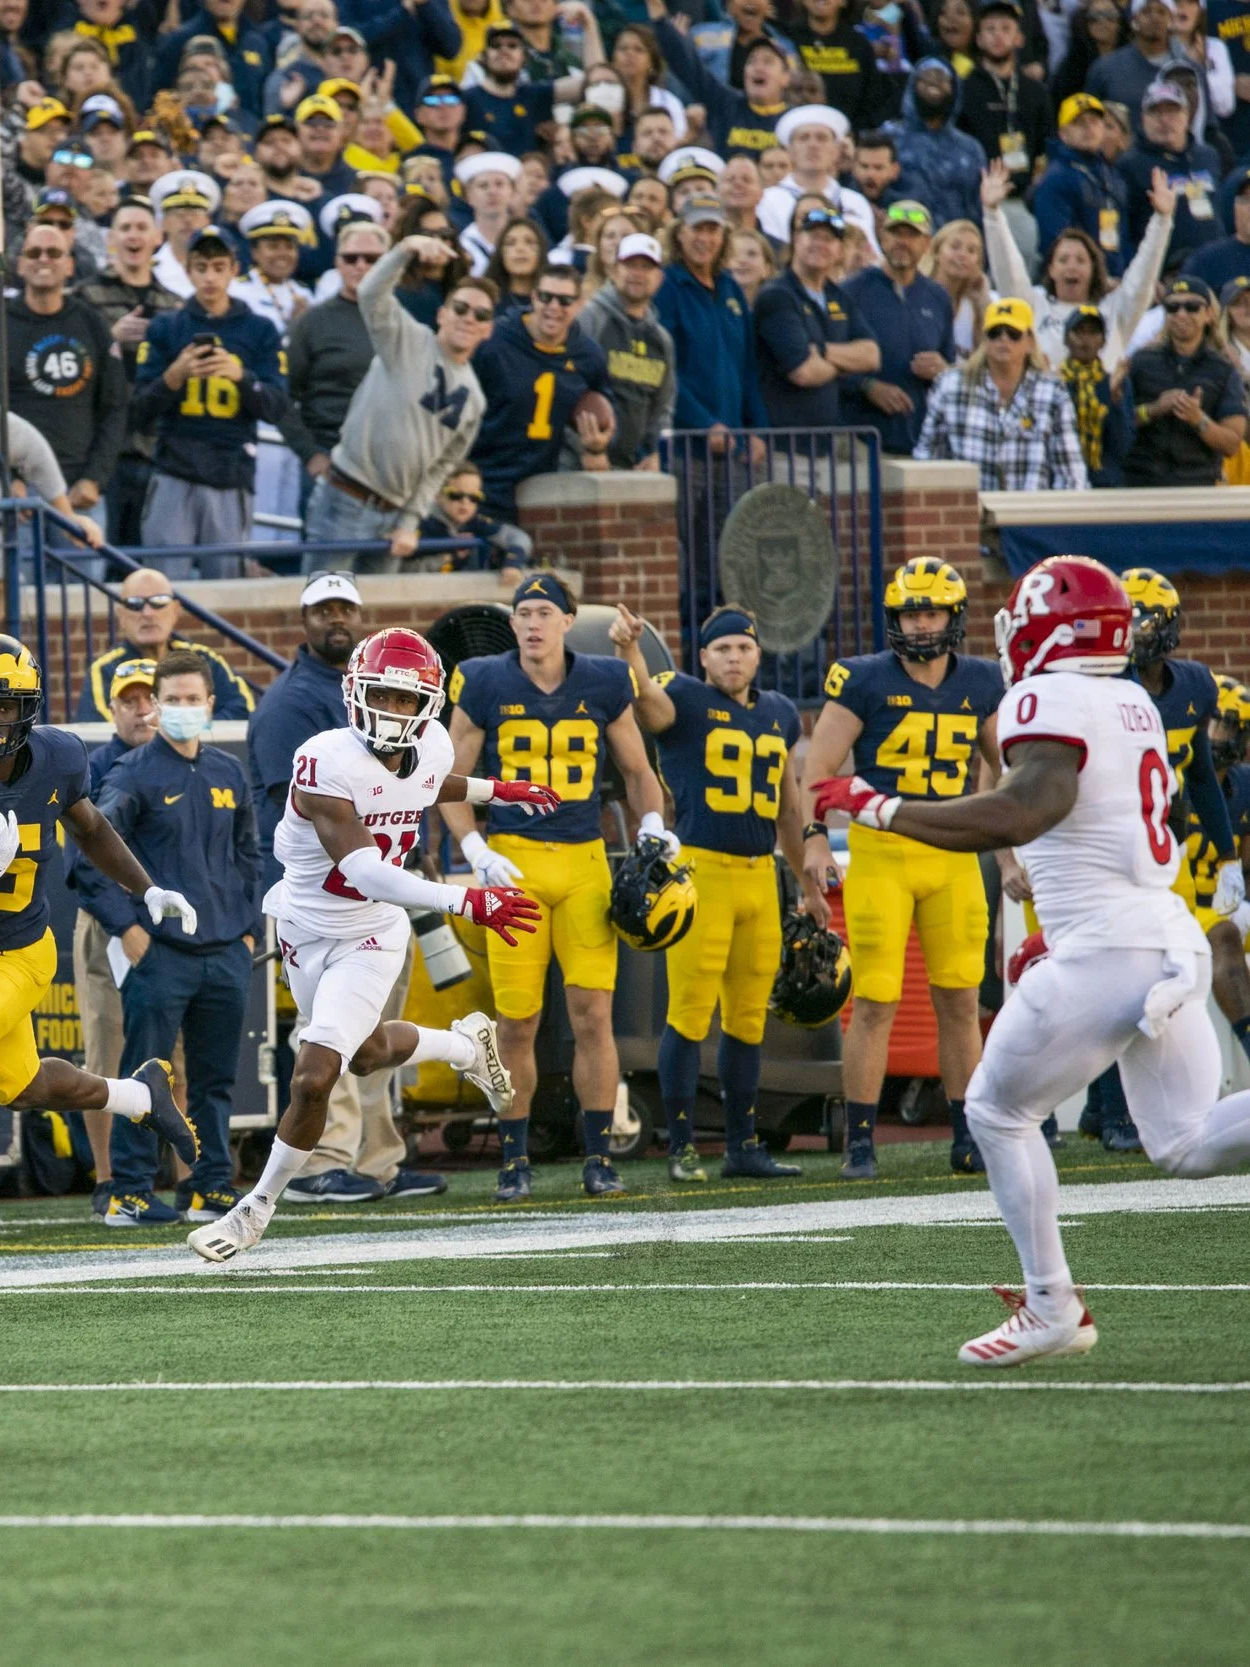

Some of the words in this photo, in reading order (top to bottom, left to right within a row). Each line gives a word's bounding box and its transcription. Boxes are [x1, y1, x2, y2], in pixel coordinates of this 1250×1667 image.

[44, 351, 79, 380] 46
[526, 371, 556, 440] 1
[1014, 573, 1054, 616] R
[1016, 693, 1038, 725] 0
[296, 755, 317, 787] 21
[497, 719, 598, 801] 88
[705, 727, 788, 820] 93
[876, 711, 978, 797] 45
[210, 787, 236, 809] M
[1139, 748, 1171, 865] 0
[355, 942, 383, 951] adidas
[477, 1027, 509, 1093] ADIZERO
